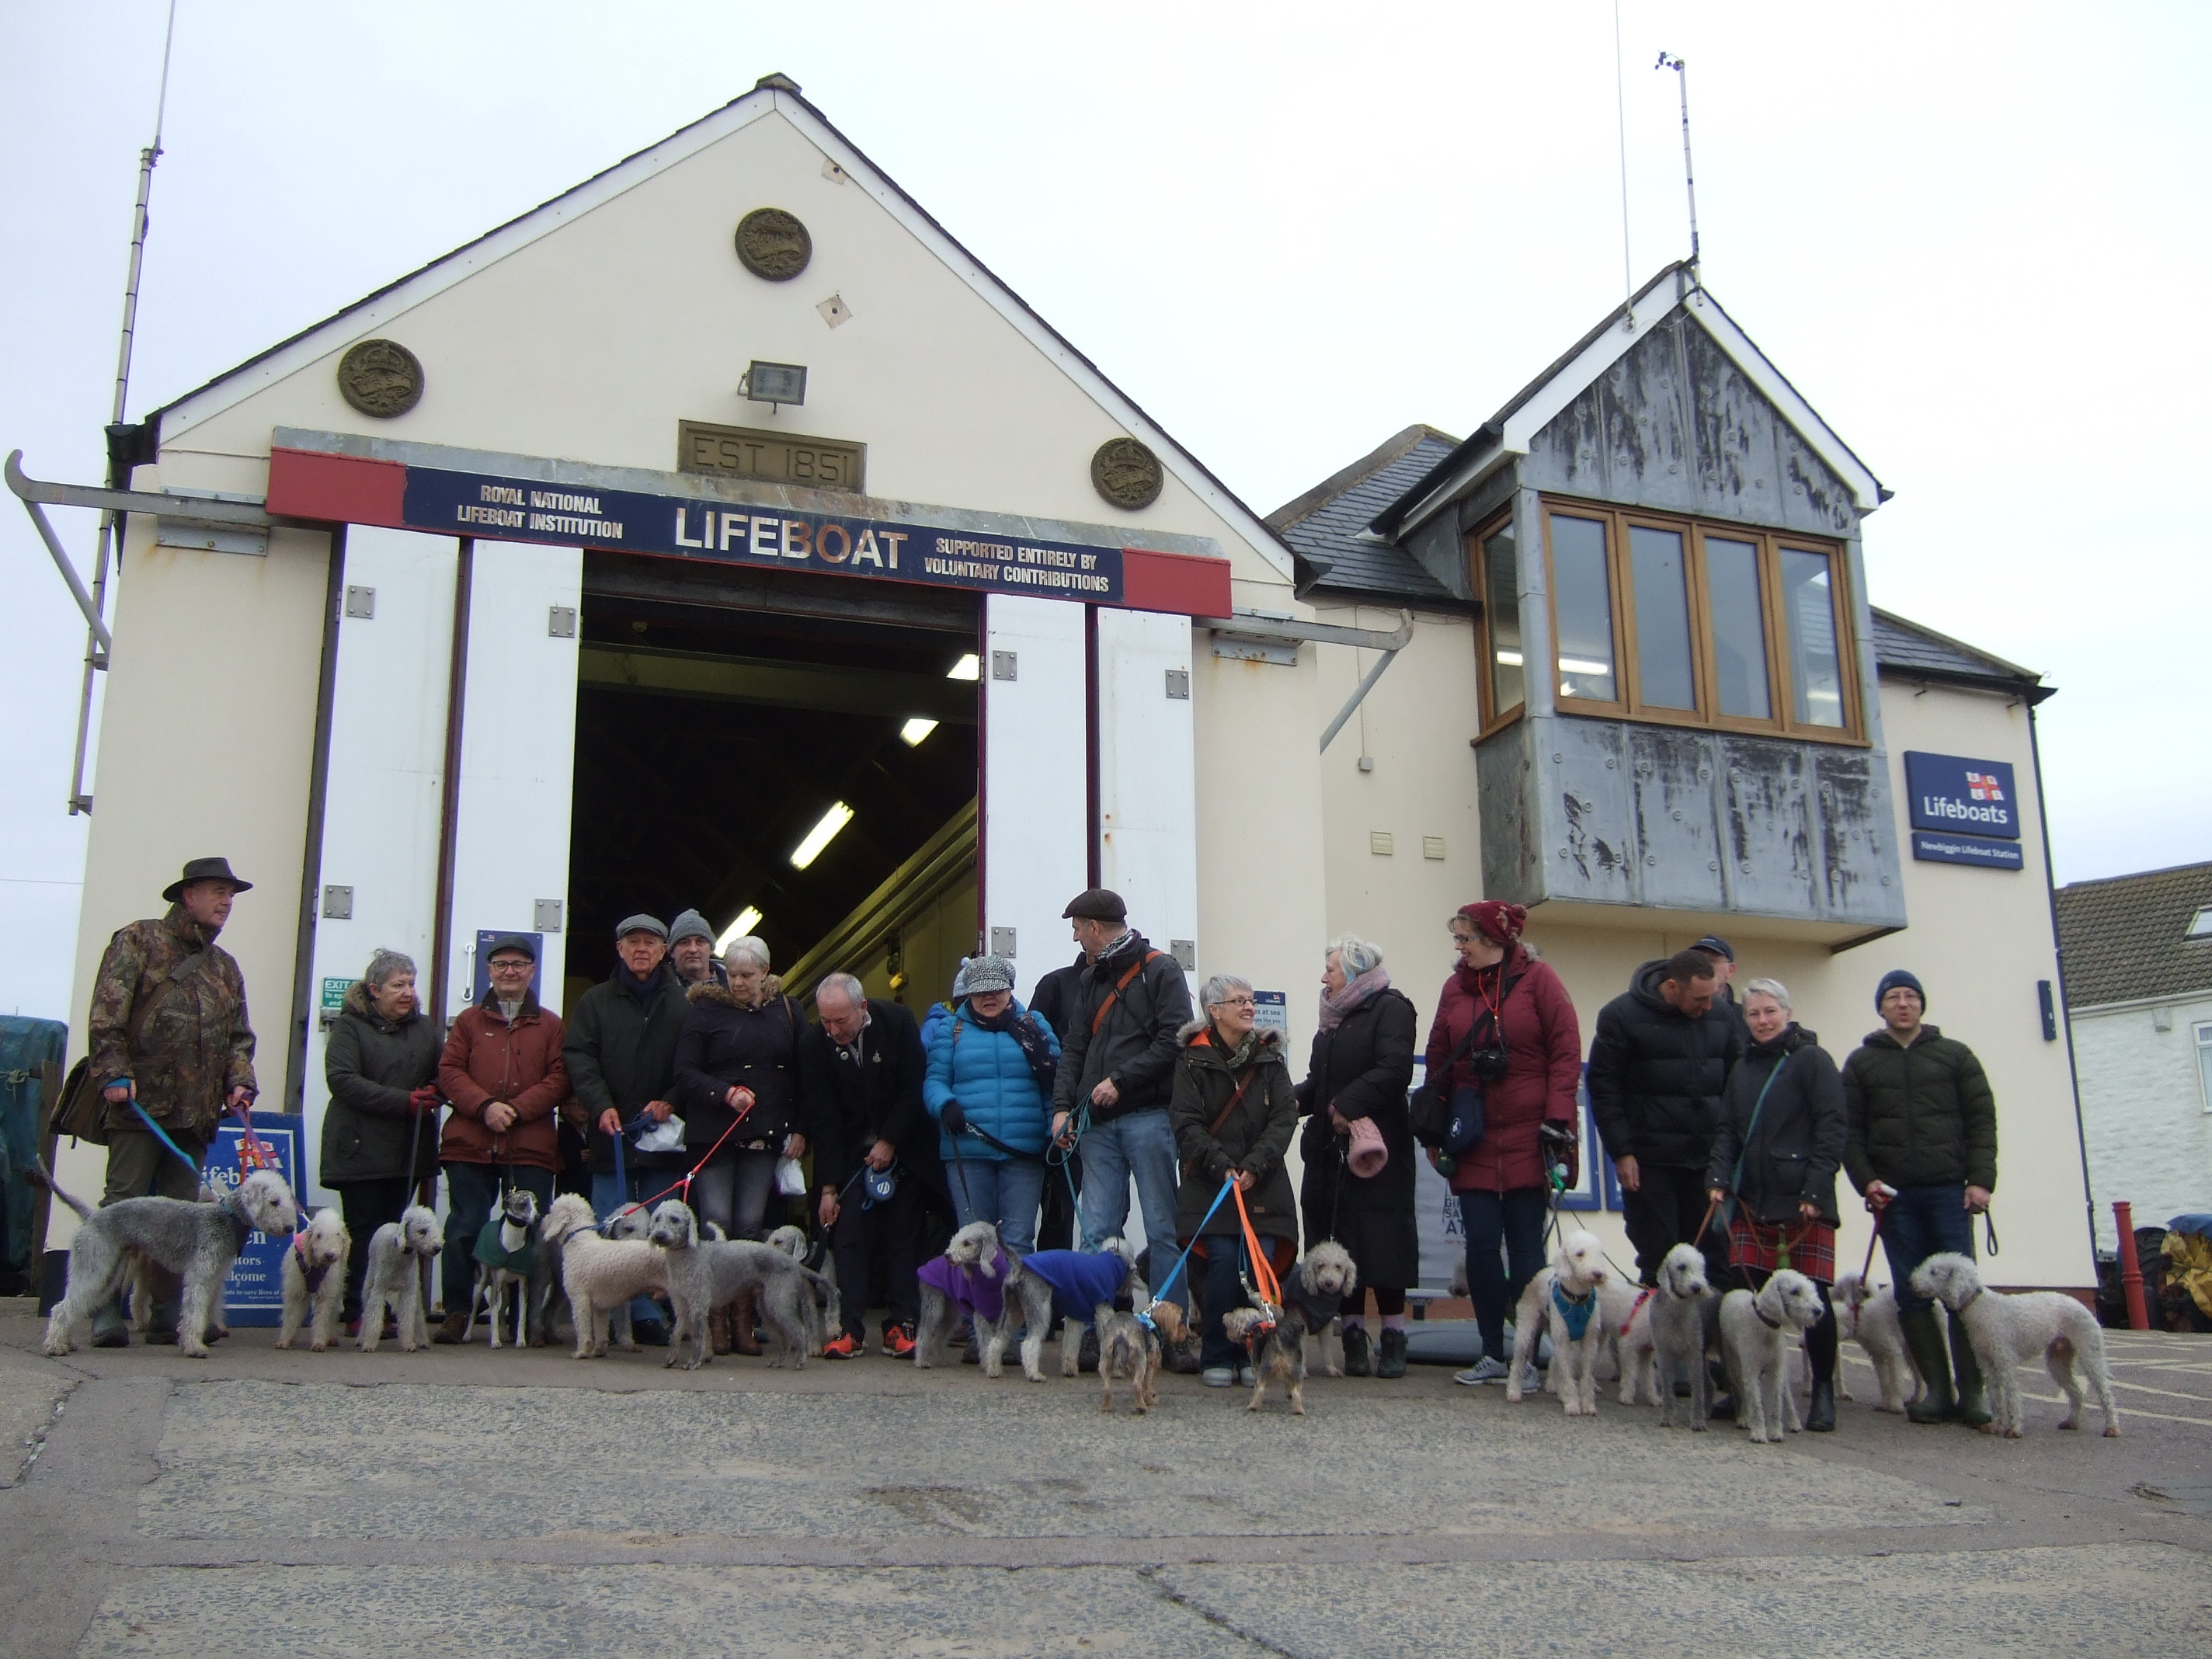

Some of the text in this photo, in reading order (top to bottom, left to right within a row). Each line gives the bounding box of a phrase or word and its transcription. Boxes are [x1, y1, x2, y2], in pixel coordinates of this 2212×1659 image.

[694, 436, 847, 483] EST 1851
[481, 485, 603, 515] ROYAL NATIONAL
[457, 505, 623, 539] LIFEBOAT INSTITUTION
[675, 507, 909, 569] LIFEBOAT
[936, 537, 1097, 571] SUPPORTED ENTIRELY BY
[924, 557, 1109, 593] VOLUNTARY CONTRIBUTIONS
[1924, 796, 2008, 824] Lifeboats
[1962, 845, 1991, 857] Lifeboat
[1993, 849, 2019, 859] Station
[325, 980, 350, 989] EXIT
